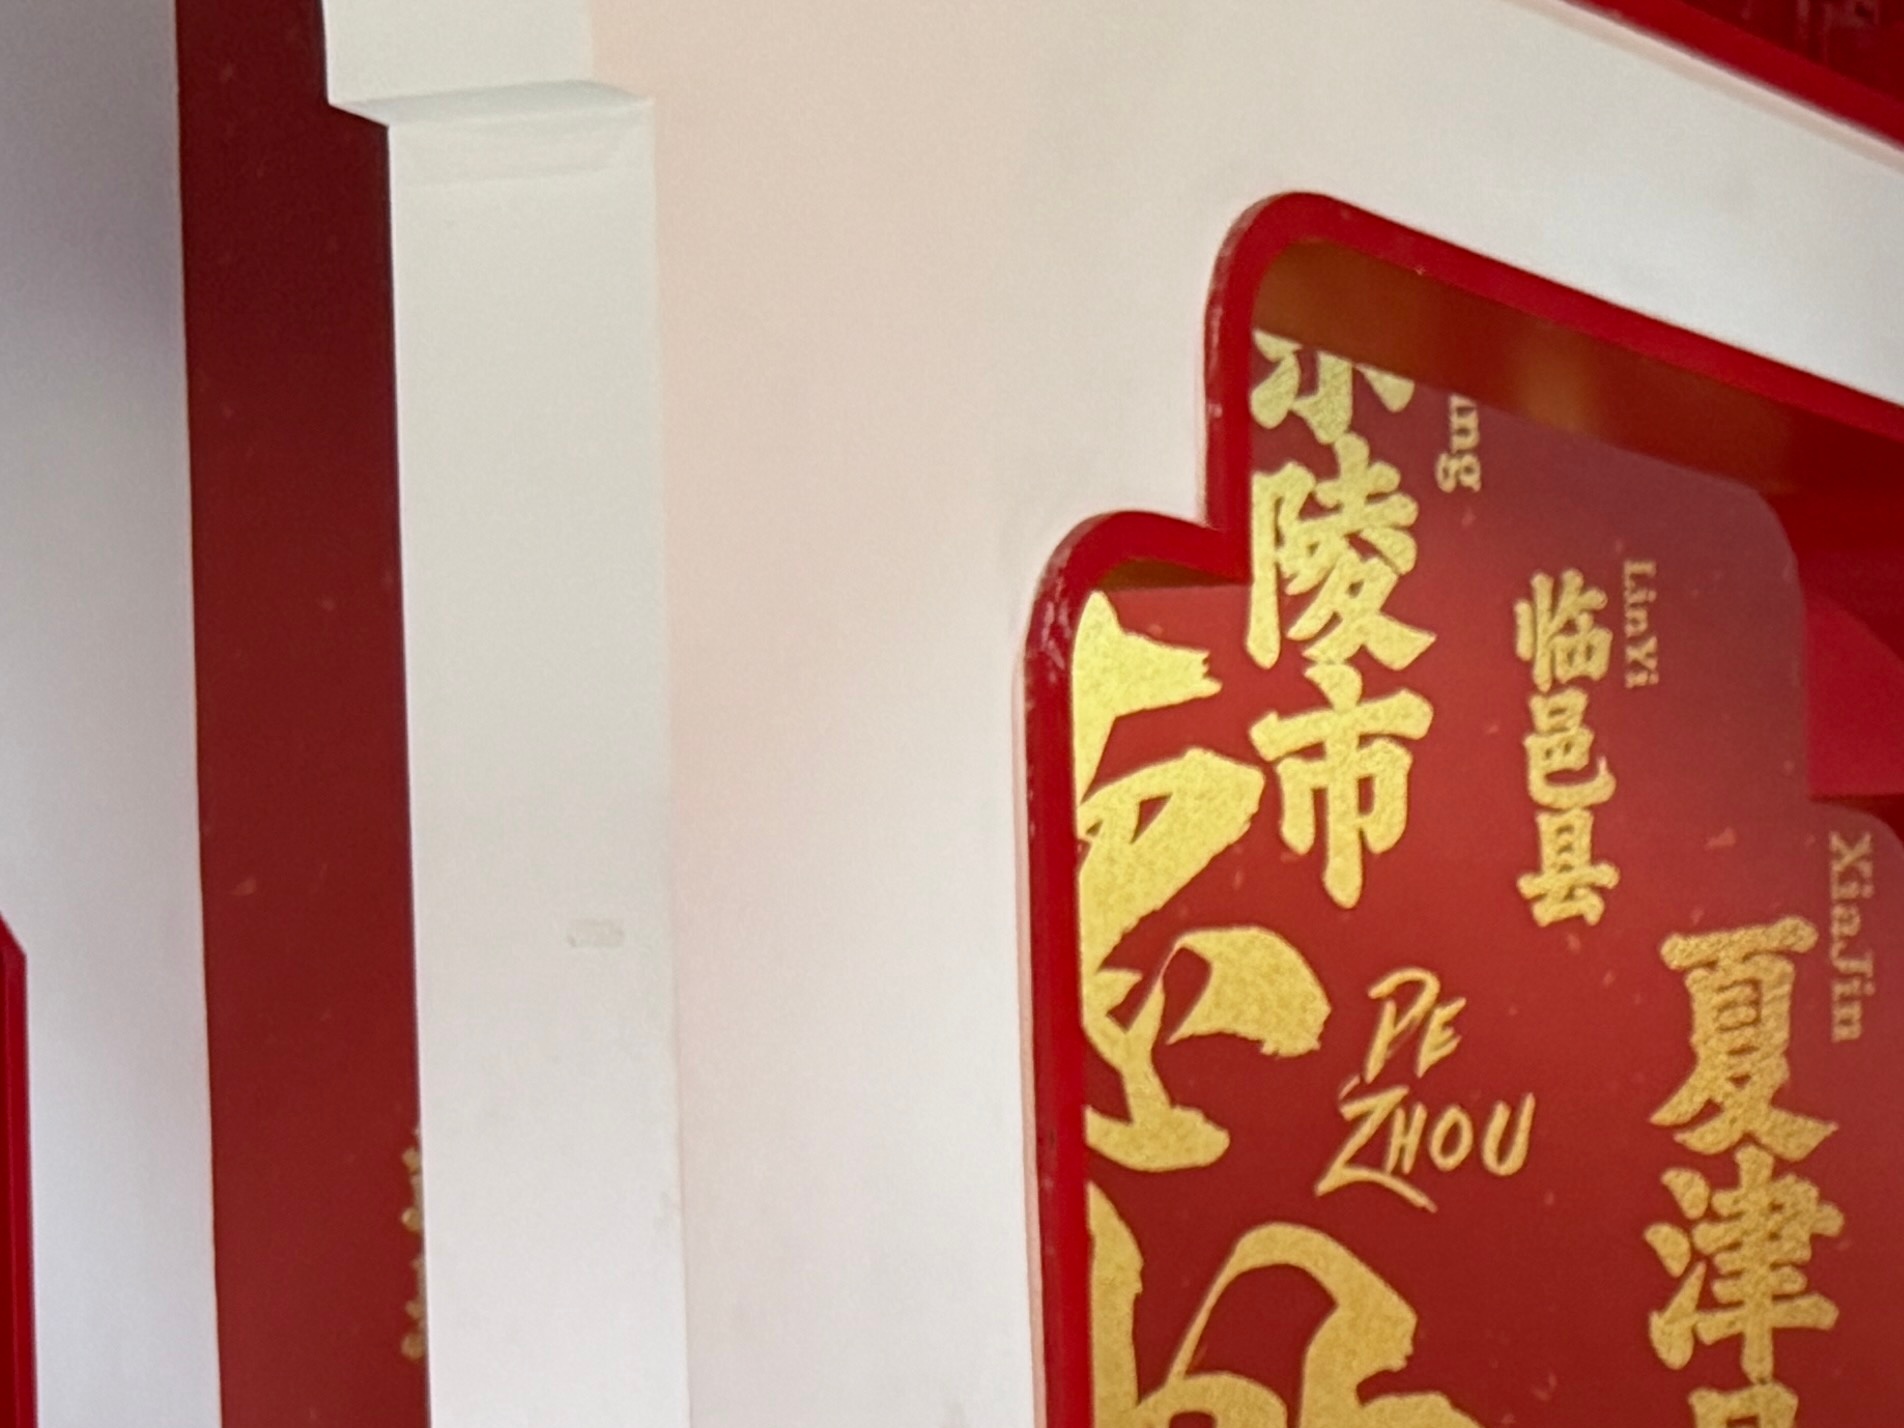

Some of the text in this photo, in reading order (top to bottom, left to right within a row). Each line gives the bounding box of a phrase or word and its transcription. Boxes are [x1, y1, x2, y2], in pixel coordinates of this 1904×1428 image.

[1621, 558, 1661, 691] LinYi
[1513, 568, 1620, 927] 临邑县
[1828, 830, 1874, 1044] XiaJin
[1313, 1076, 1537, 1215] ZHOU
